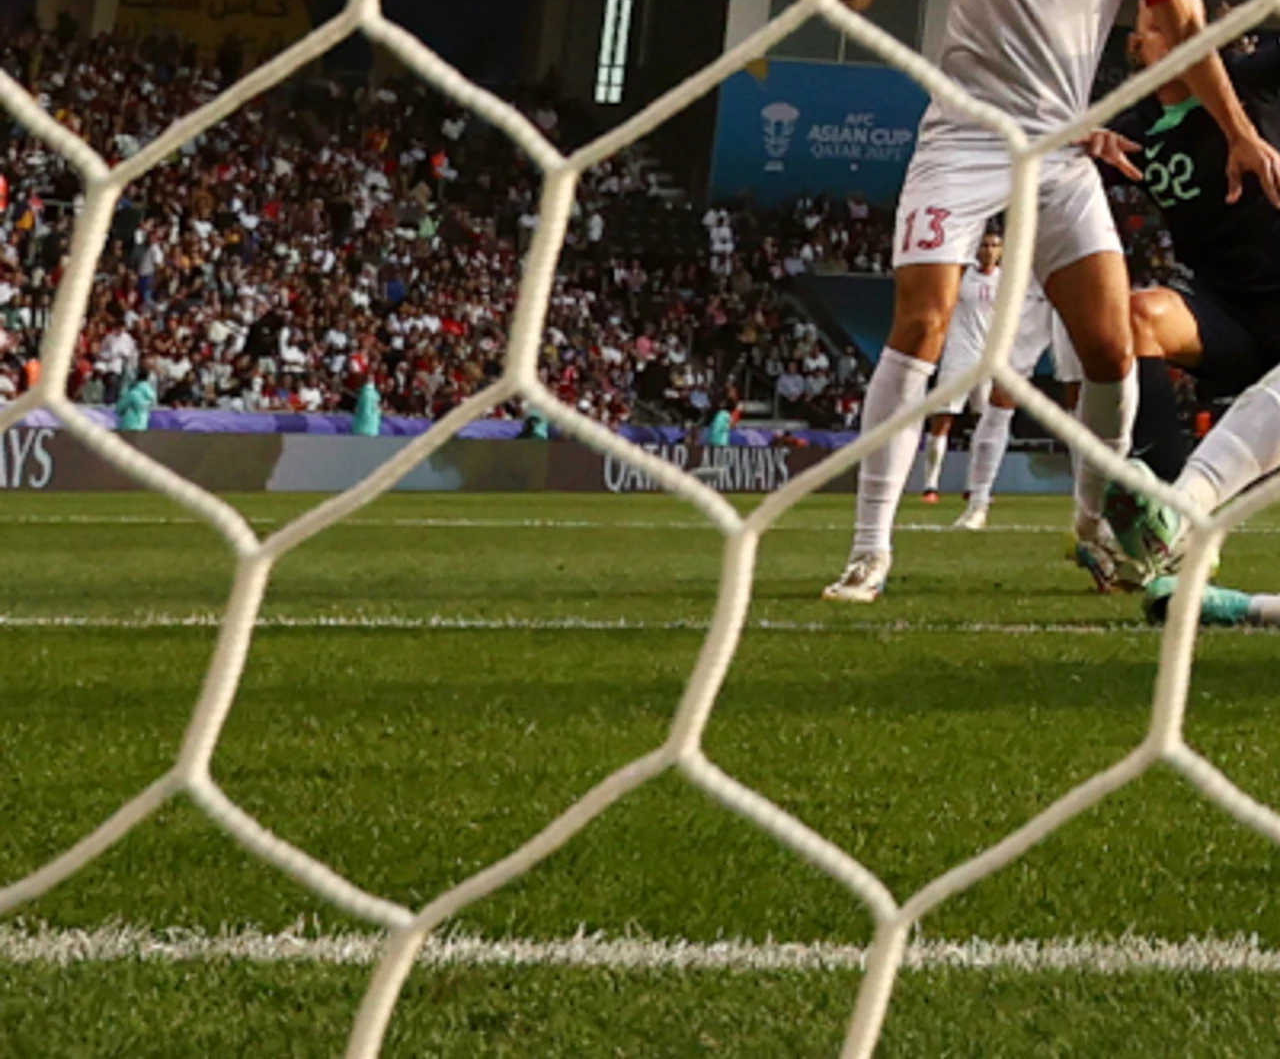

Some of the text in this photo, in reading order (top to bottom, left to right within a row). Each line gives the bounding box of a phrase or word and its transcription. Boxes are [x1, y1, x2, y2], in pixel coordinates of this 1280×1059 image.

[807, 124, 913, 147] ASIAN CUP
[846, 112, 875, 126] AFC
[1145, 153, 1201, 208] 22
[902, 206, 952, 254] 13
